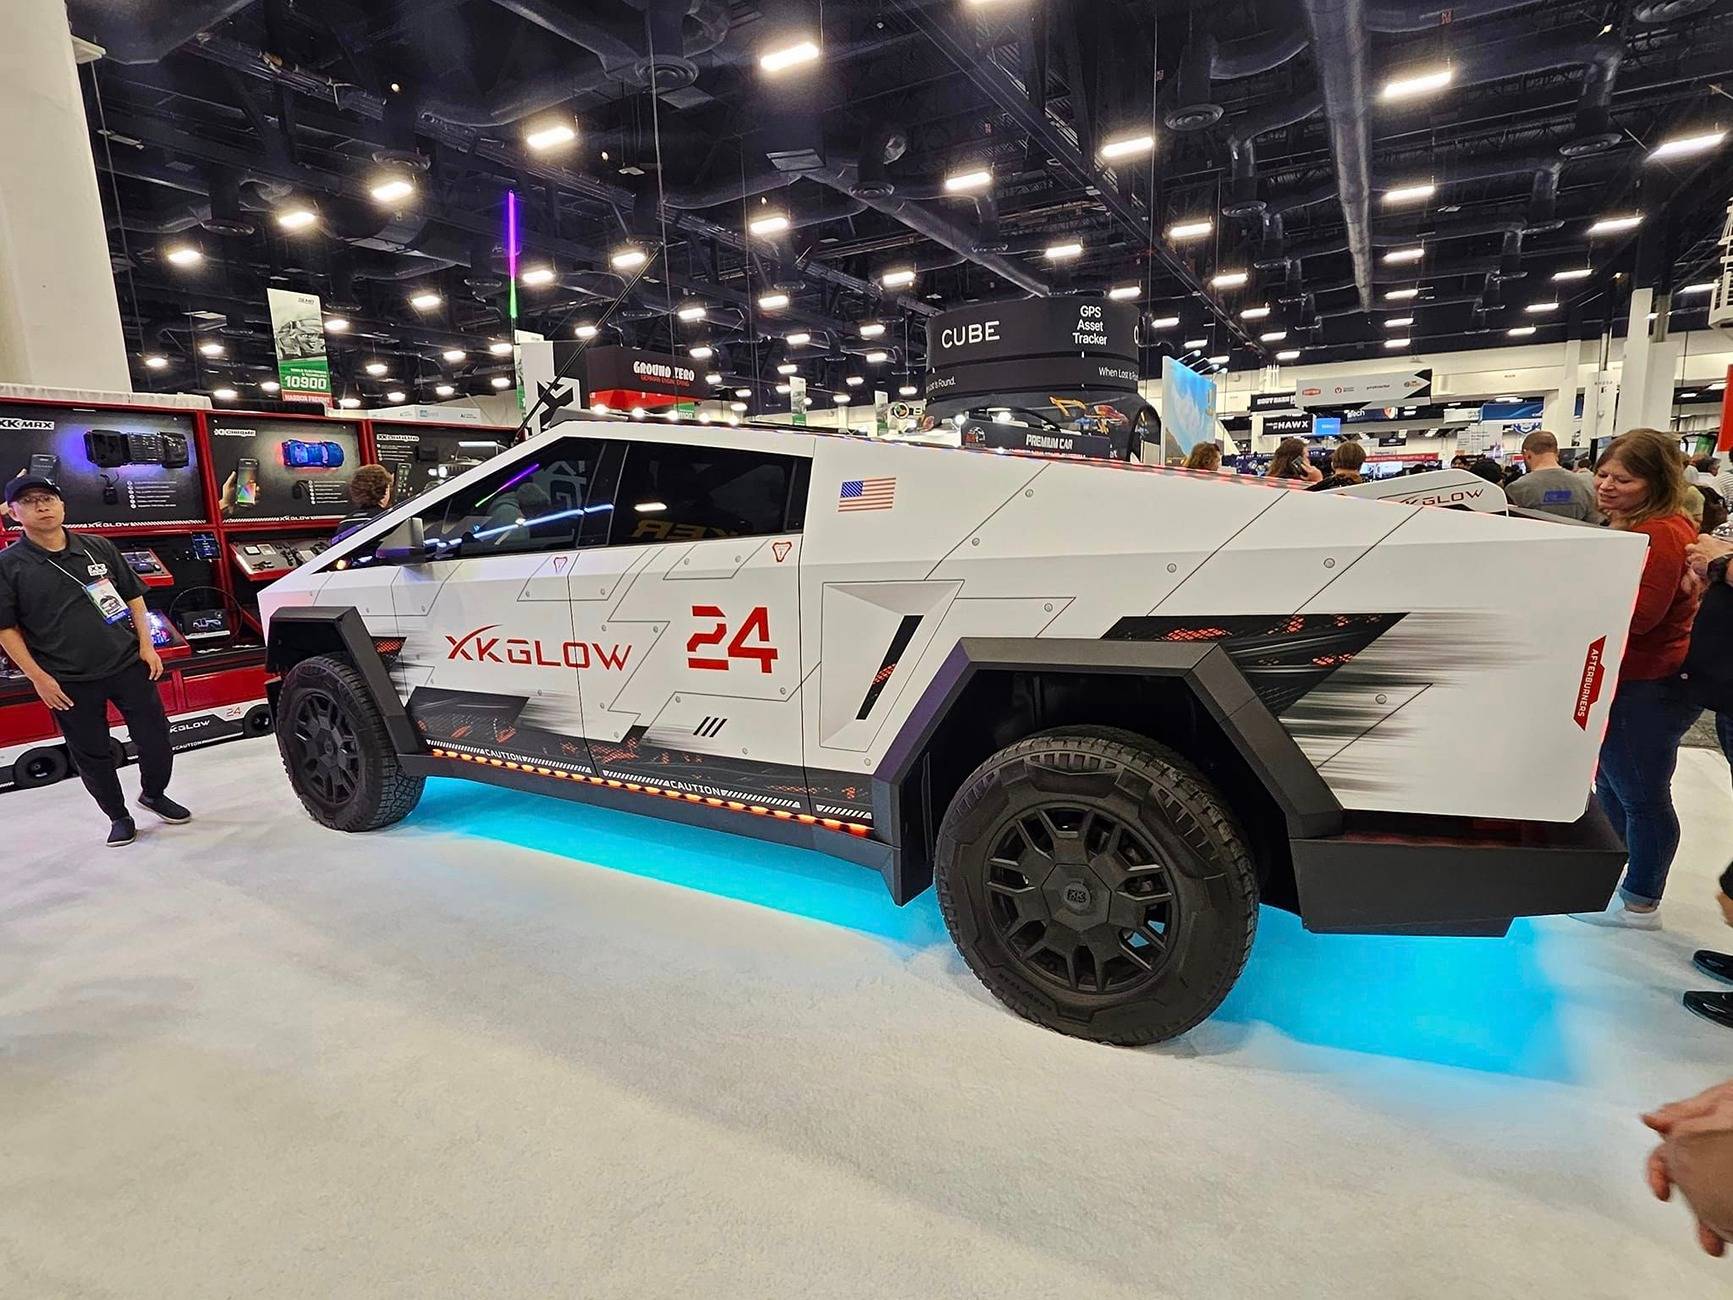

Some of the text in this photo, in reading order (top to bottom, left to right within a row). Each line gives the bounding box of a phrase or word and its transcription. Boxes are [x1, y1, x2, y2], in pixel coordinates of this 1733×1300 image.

[1080, 305, 1102, 318] GPS
[1077, 319, 1104, 332] Asset
[941, 320, 1000, 349] CUBE
[1072, 332, 1108, 346] Tracker
[633, 361, 672, 378] GROUND
[1098, 366, 1118, 377] When
[285, 375, 328, 390] 10900
[1278, 420, 1309, 430] HAWX
[1025, 434, 1074, 450] PREMIUM CAR
[686, 604, 780, 675] 24
[443, 623, 634, 672] XKGLOW
[1577, 648, 1599, 717] AFTERBURNERS
[225, 706, 242, 718] 24
[485, 749, 523, 762] CAUTION
[669, 779, 722, 797] CAUTION
